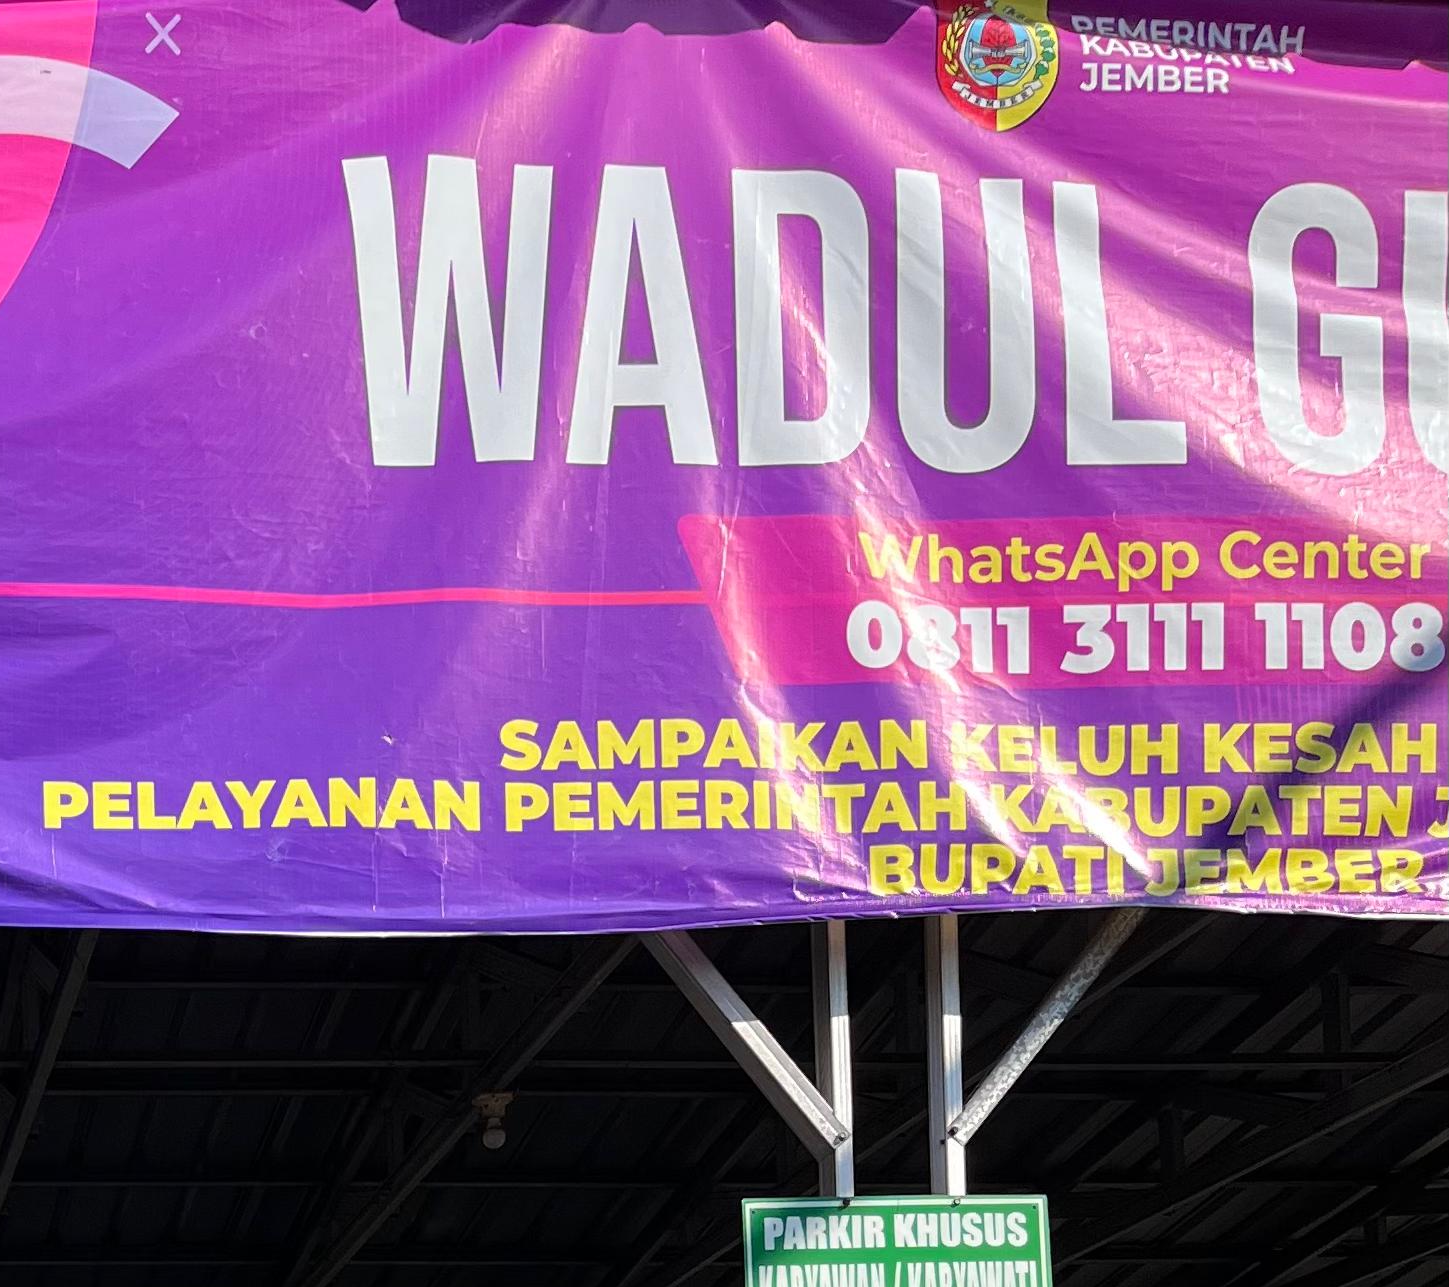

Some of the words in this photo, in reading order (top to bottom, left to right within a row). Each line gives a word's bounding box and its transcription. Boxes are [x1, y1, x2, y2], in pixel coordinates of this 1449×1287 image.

[1070, 15, 1305, 55] PEMERINTAH
[1079, 63, 1230, 94] JEMBER
[342, 155, 1187, 474] WADUL
[858, 530, 1199, 593] WhatsApp
[1220, 530, 1428, 583] Center
[847, 602, 1030, 675] 0811
[1060, 602, 1225, 675] 3111
[1255, 602, 1445, 675] 1108
[499, 718, 928, 773] SAMPAIKAN
[951, 722, 1178, 776] KELUH
[1202, 722, 1437, 774] KESAH
[42, 777, 481, 832] PELAYANAN
[504, 778, 966, 833] PEMERINTAH
[990, 784, 1413, 838] KABUPATEN
[869, 843, 1124, 897] BUPATI
[1144, 848, 1425, 898] JEMBER
[763, 1214, 886, 1251] PARKIR
[893, 1212, 1029, 1248] KHUSUS
